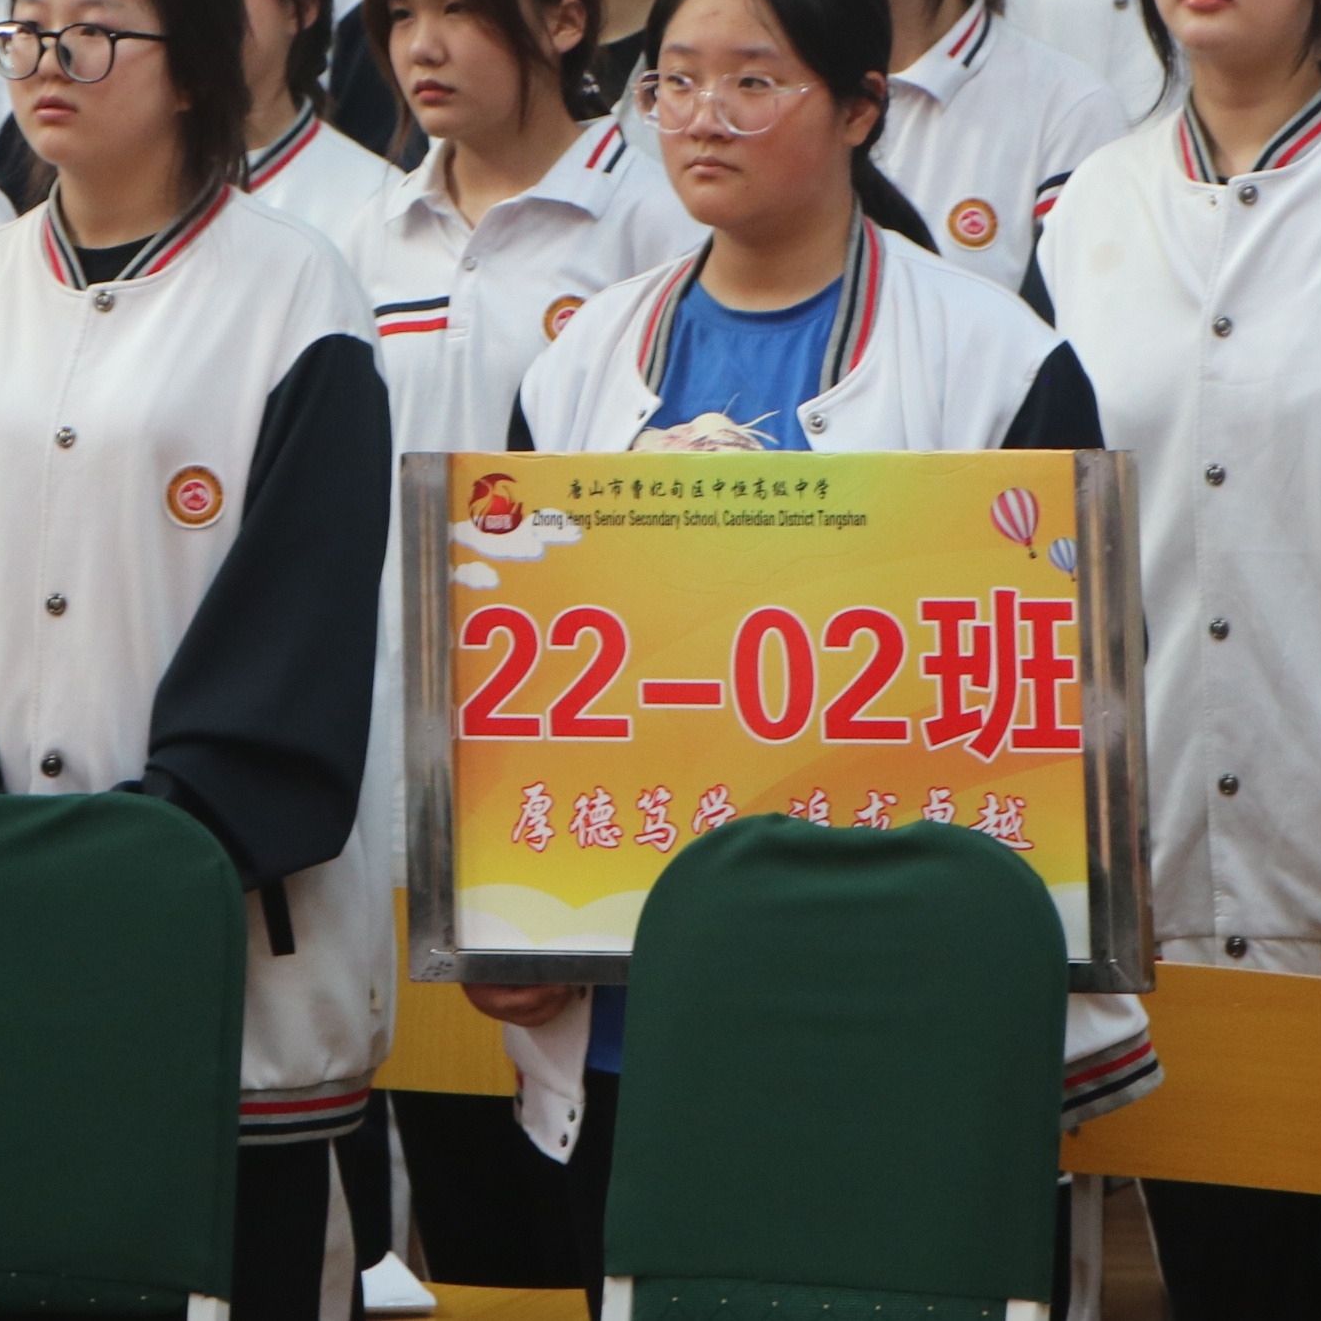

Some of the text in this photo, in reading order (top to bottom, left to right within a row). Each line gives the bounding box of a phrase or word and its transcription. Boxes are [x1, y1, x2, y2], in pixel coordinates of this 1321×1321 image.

[532, 509, 563, 529] Zhong
[566, 510, 591, 530] Heng
[594, 510, 626, 526] Senior
[629, 510, 680, 530] Secondary
[683, 510, 720, 528] School,
[723, 510, 775, 526] Caofeidian
[778, 510, 814, 526] District
[817, 510, 866, 530] Tangshan
[511, 781, 737, 853] 厚德笃学
